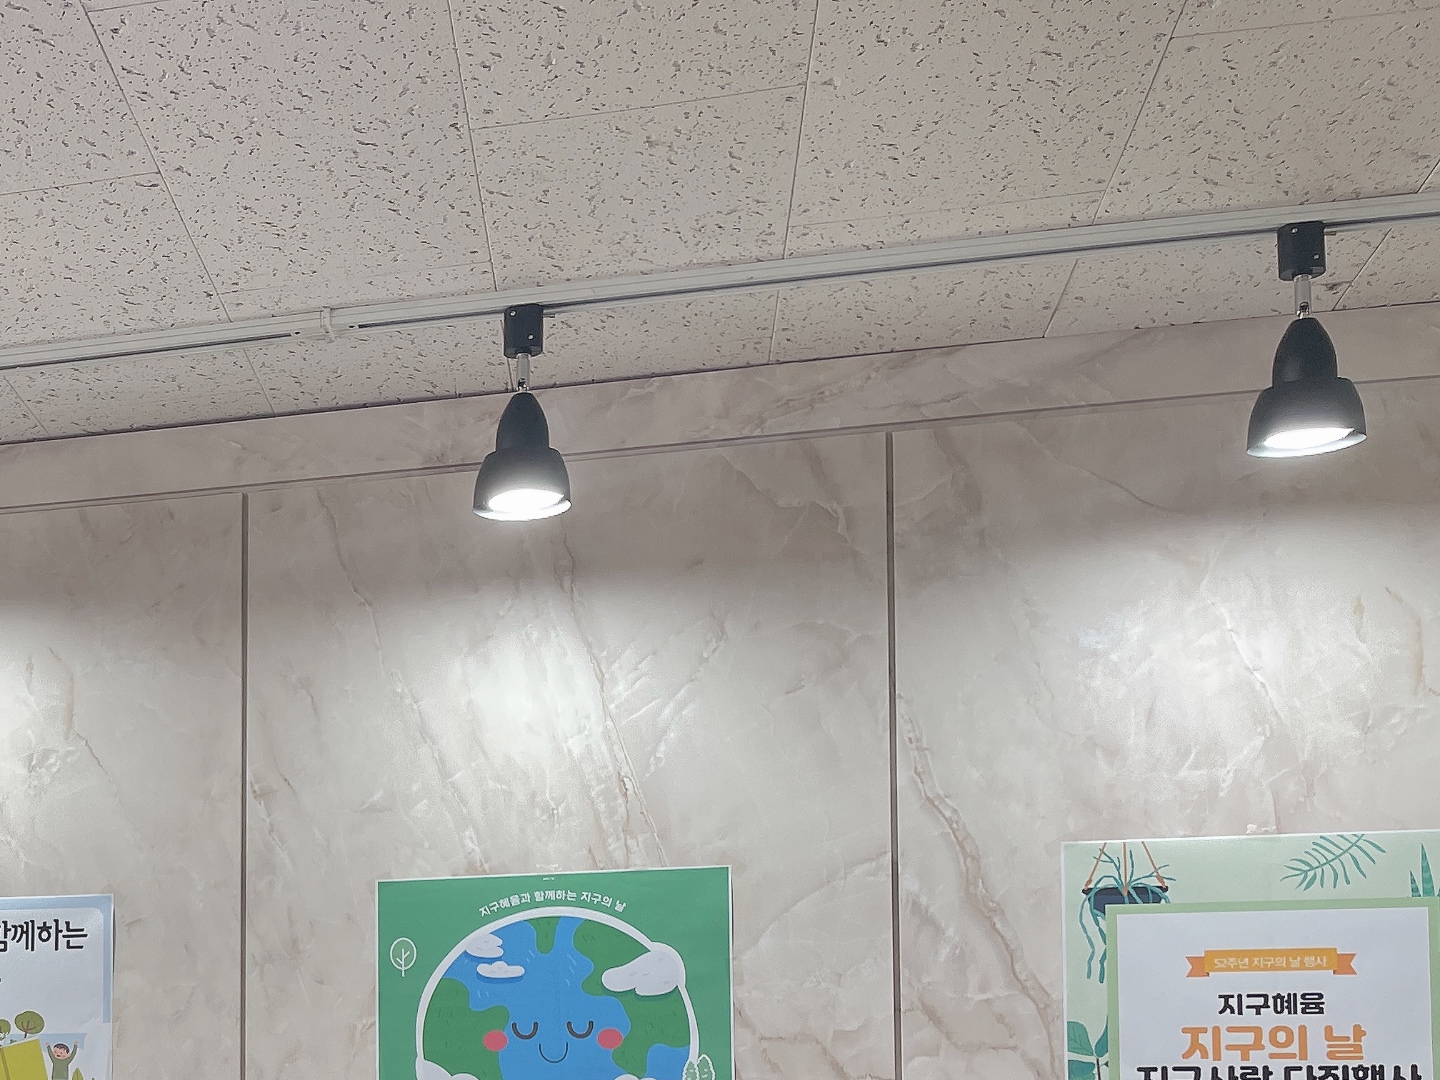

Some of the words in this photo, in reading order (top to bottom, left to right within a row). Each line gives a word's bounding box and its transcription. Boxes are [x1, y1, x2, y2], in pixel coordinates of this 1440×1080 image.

[534, 889, 577, 902] 함께하는
[580, 891, 613, 908] 지구의
[614, 900, 627, 913] 날
[1214, 957, 1249, 969] 52주년
[1252, 956, 1286, 968] 지구의
[1289, 956, 1301, 968] 날
[1303, 955, 1327, 968] 행사
[1218, 992, 1325, 1015] 지구혜윰
[1181, 1025, 1308, 1061] 지구의
[1324, 1024, 1367, 1060] 날
